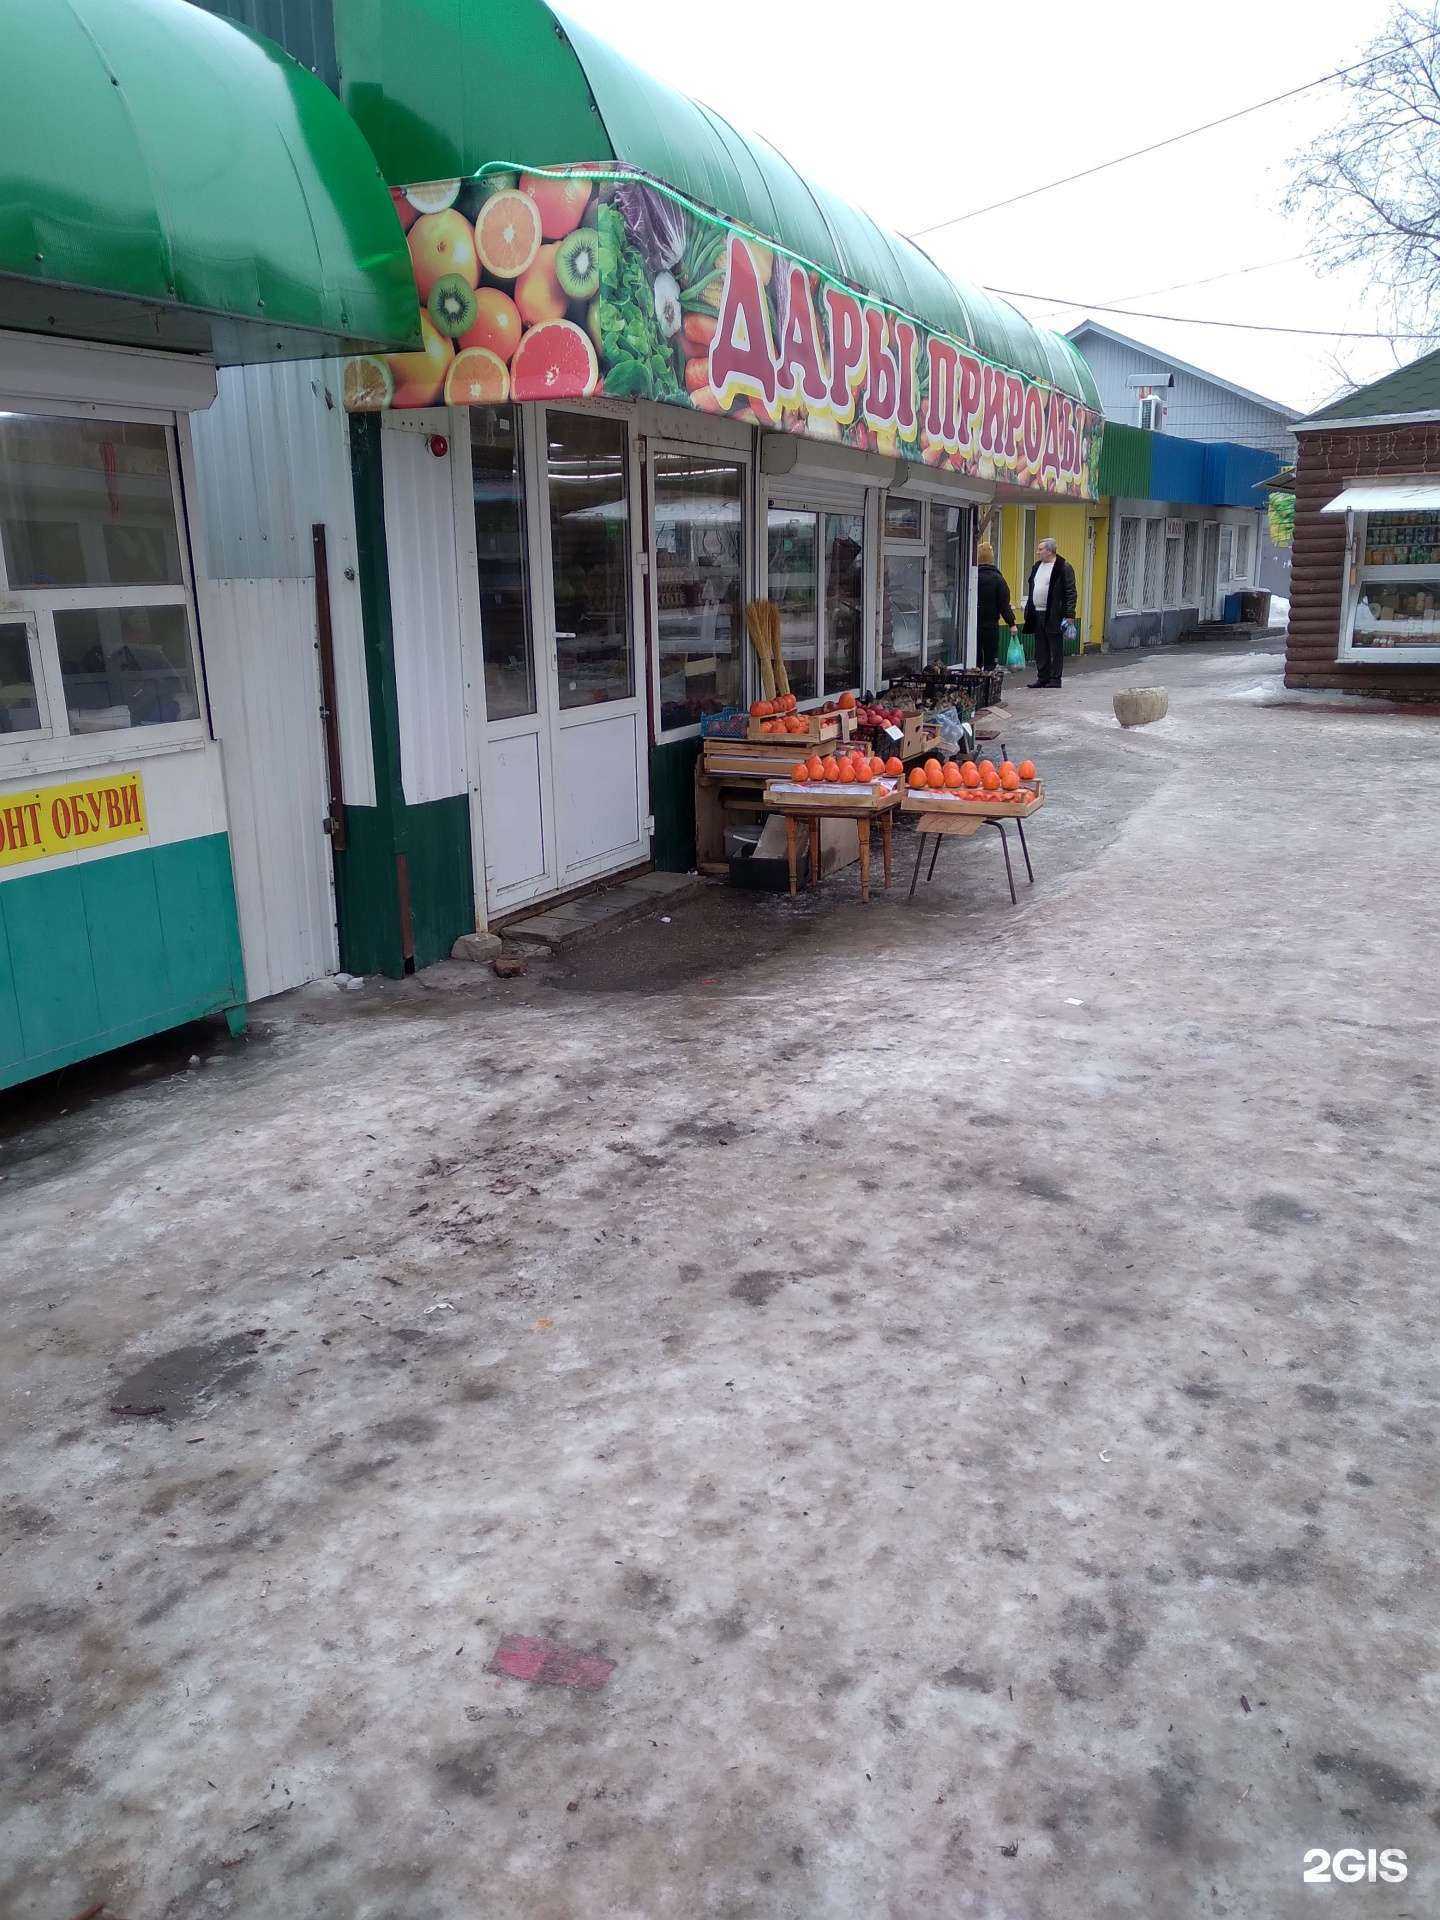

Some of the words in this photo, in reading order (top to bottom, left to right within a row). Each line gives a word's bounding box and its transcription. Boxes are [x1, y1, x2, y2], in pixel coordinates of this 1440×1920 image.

[710, 234, 919, 434] ДАРЫ
[926, 337, 1086, 480] ПРИРОДЫ
[51, 784, 141, 839] ОБУВИ
